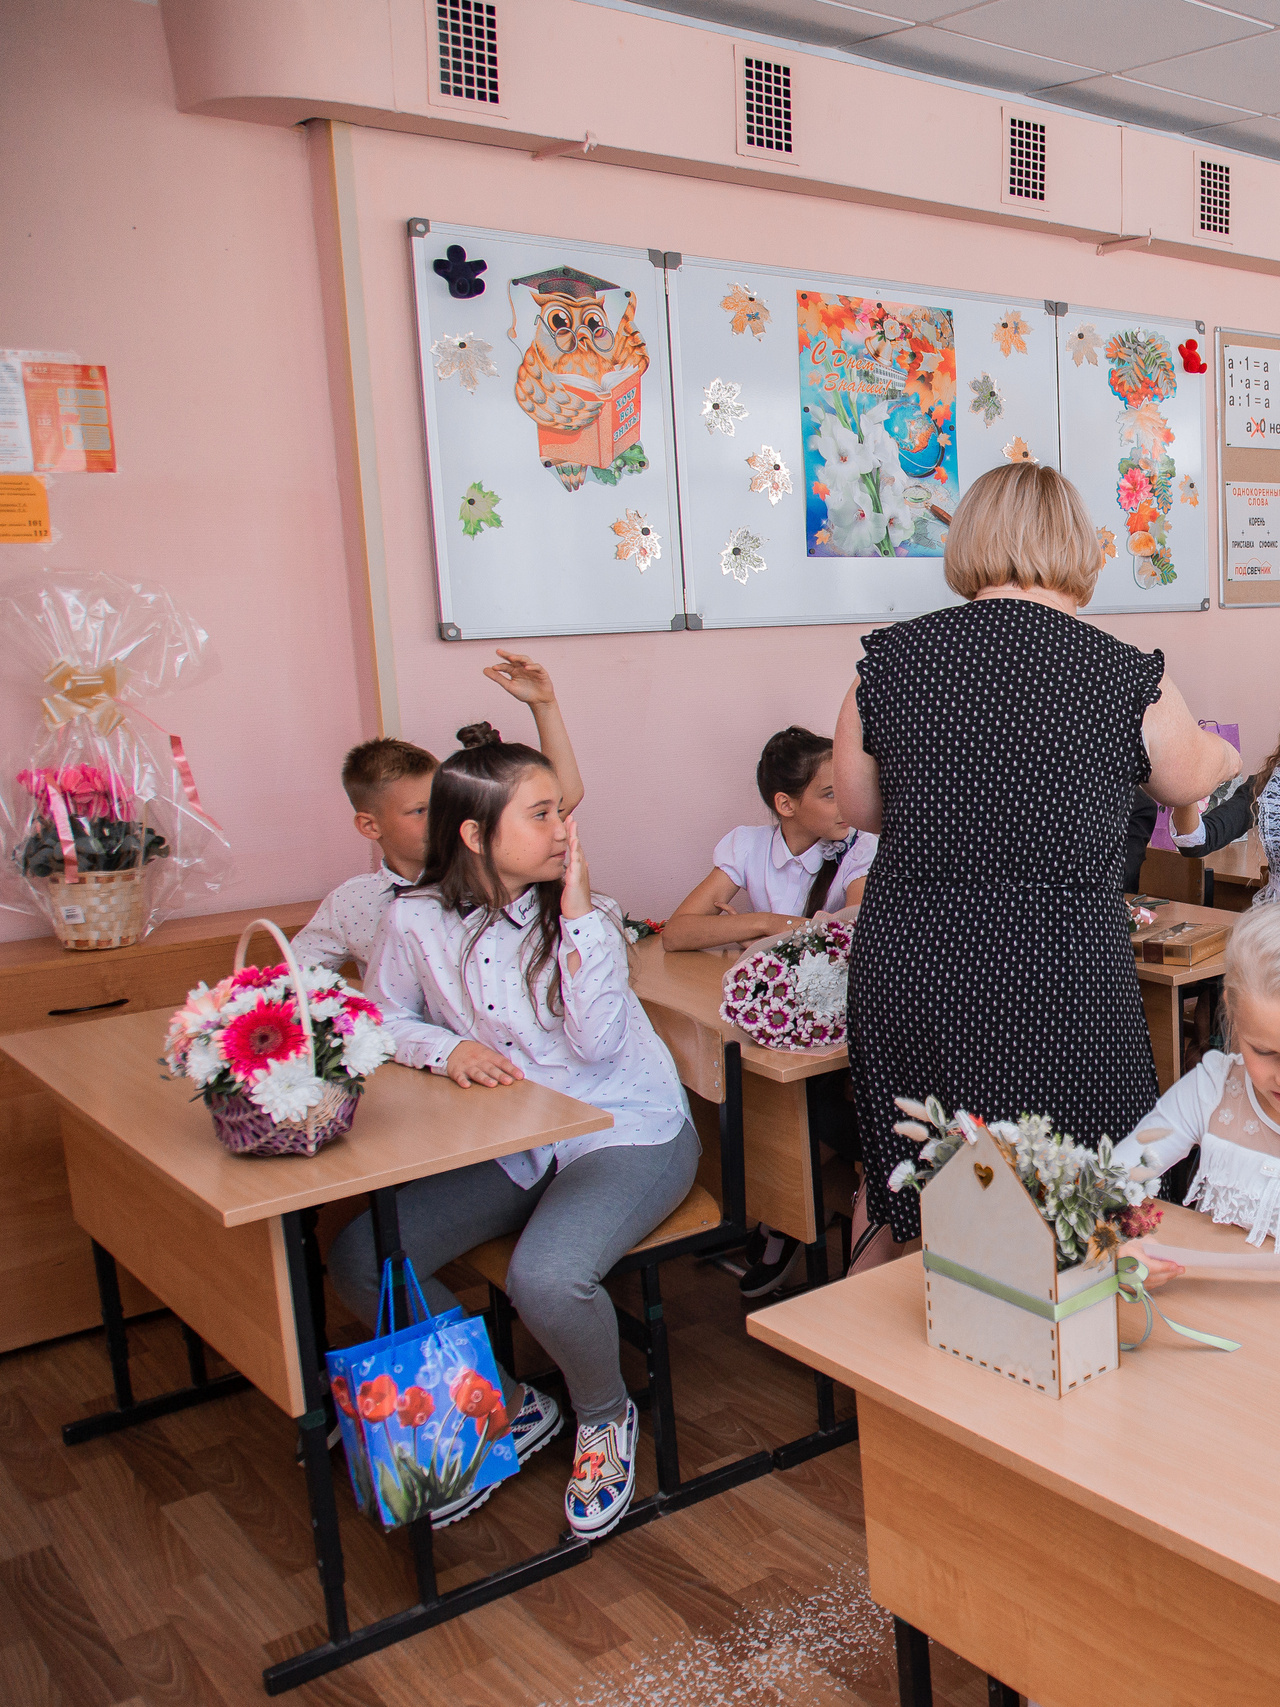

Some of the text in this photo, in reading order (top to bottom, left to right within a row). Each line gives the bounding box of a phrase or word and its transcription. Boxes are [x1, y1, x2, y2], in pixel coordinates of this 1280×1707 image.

[811, 340, 875, 371] С Днем
[824, 372, 893, 395] Знаний!
[616, 387, 637, 411] ХОЧУ
[613, 412, 640, 442] ЗНАТЬ!
[1248, 498, 1269, 506] СЛОВА
[1249, 518, 1265, 526] КОРЕНЬ
[1235, 566, 1271, 576] ПОДСВЕЧНИК
